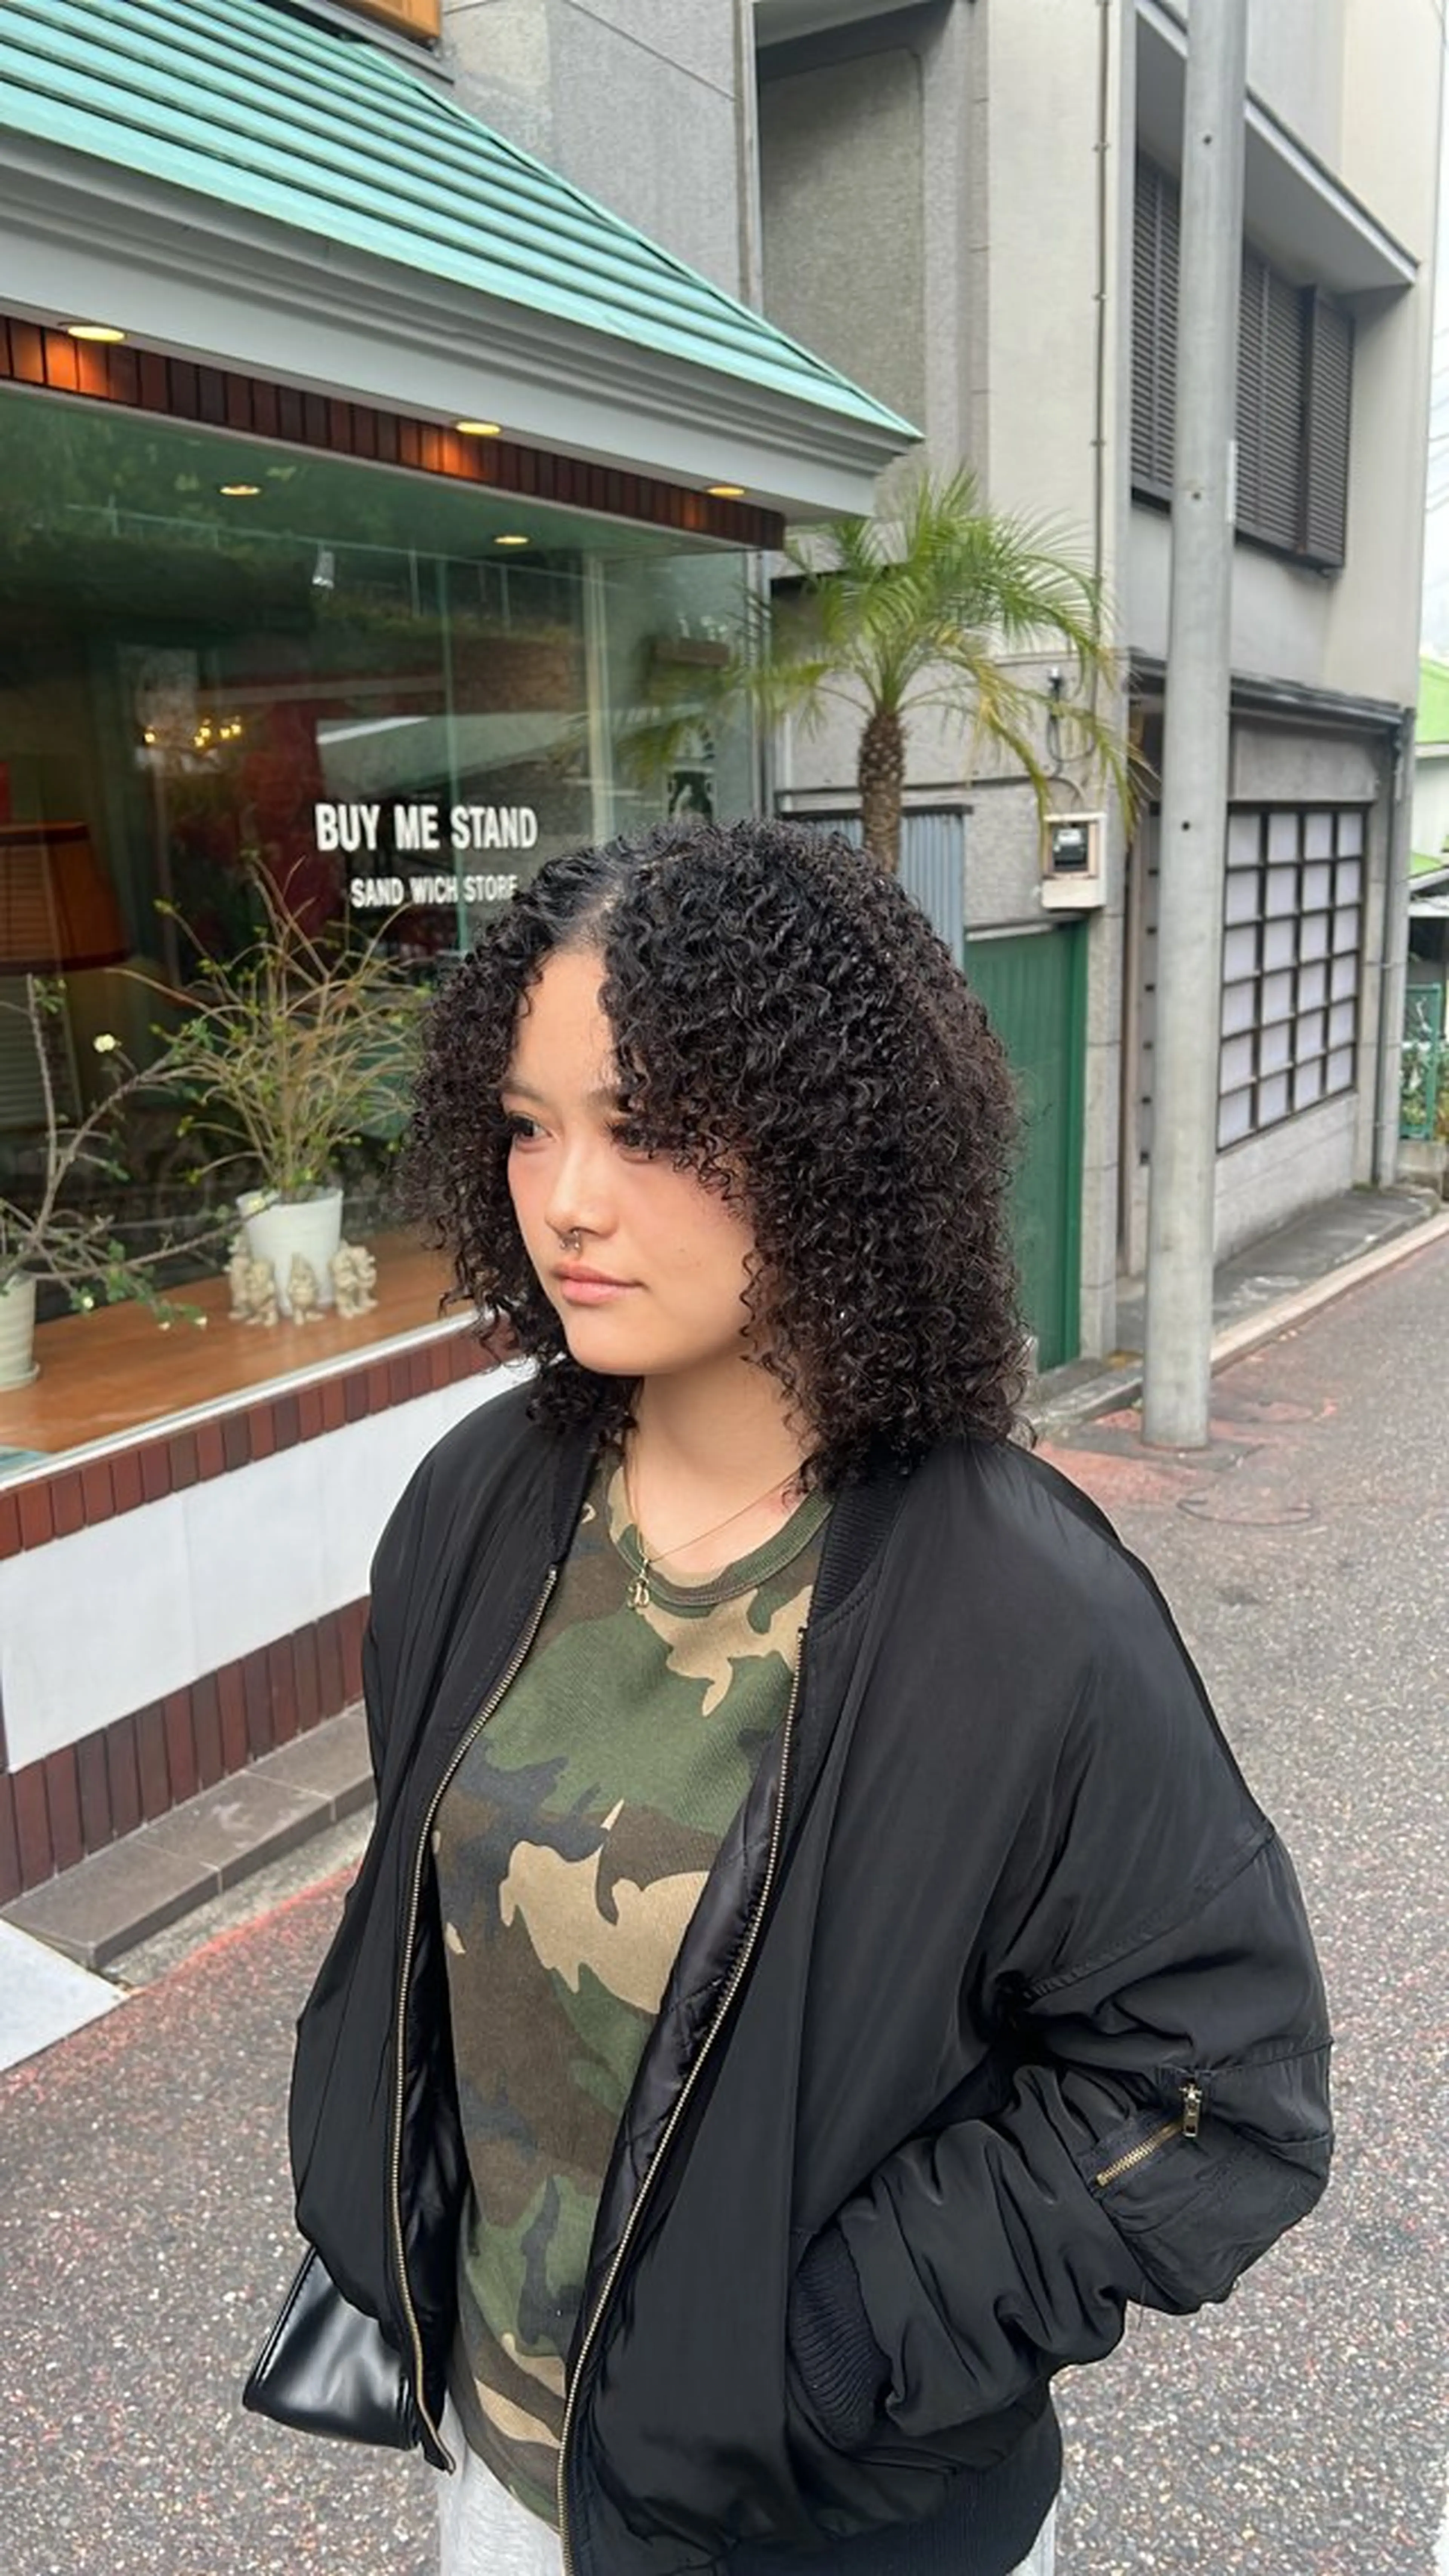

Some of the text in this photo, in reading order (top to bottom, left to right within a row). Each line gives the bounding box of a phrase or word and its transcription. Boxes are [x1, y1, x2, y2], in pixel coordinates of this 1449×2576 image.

[315, 803, 538, 851] BUY ME STAND
[350, 877, 404, 907] SAND
[409, 875, 458, 904] WICH
